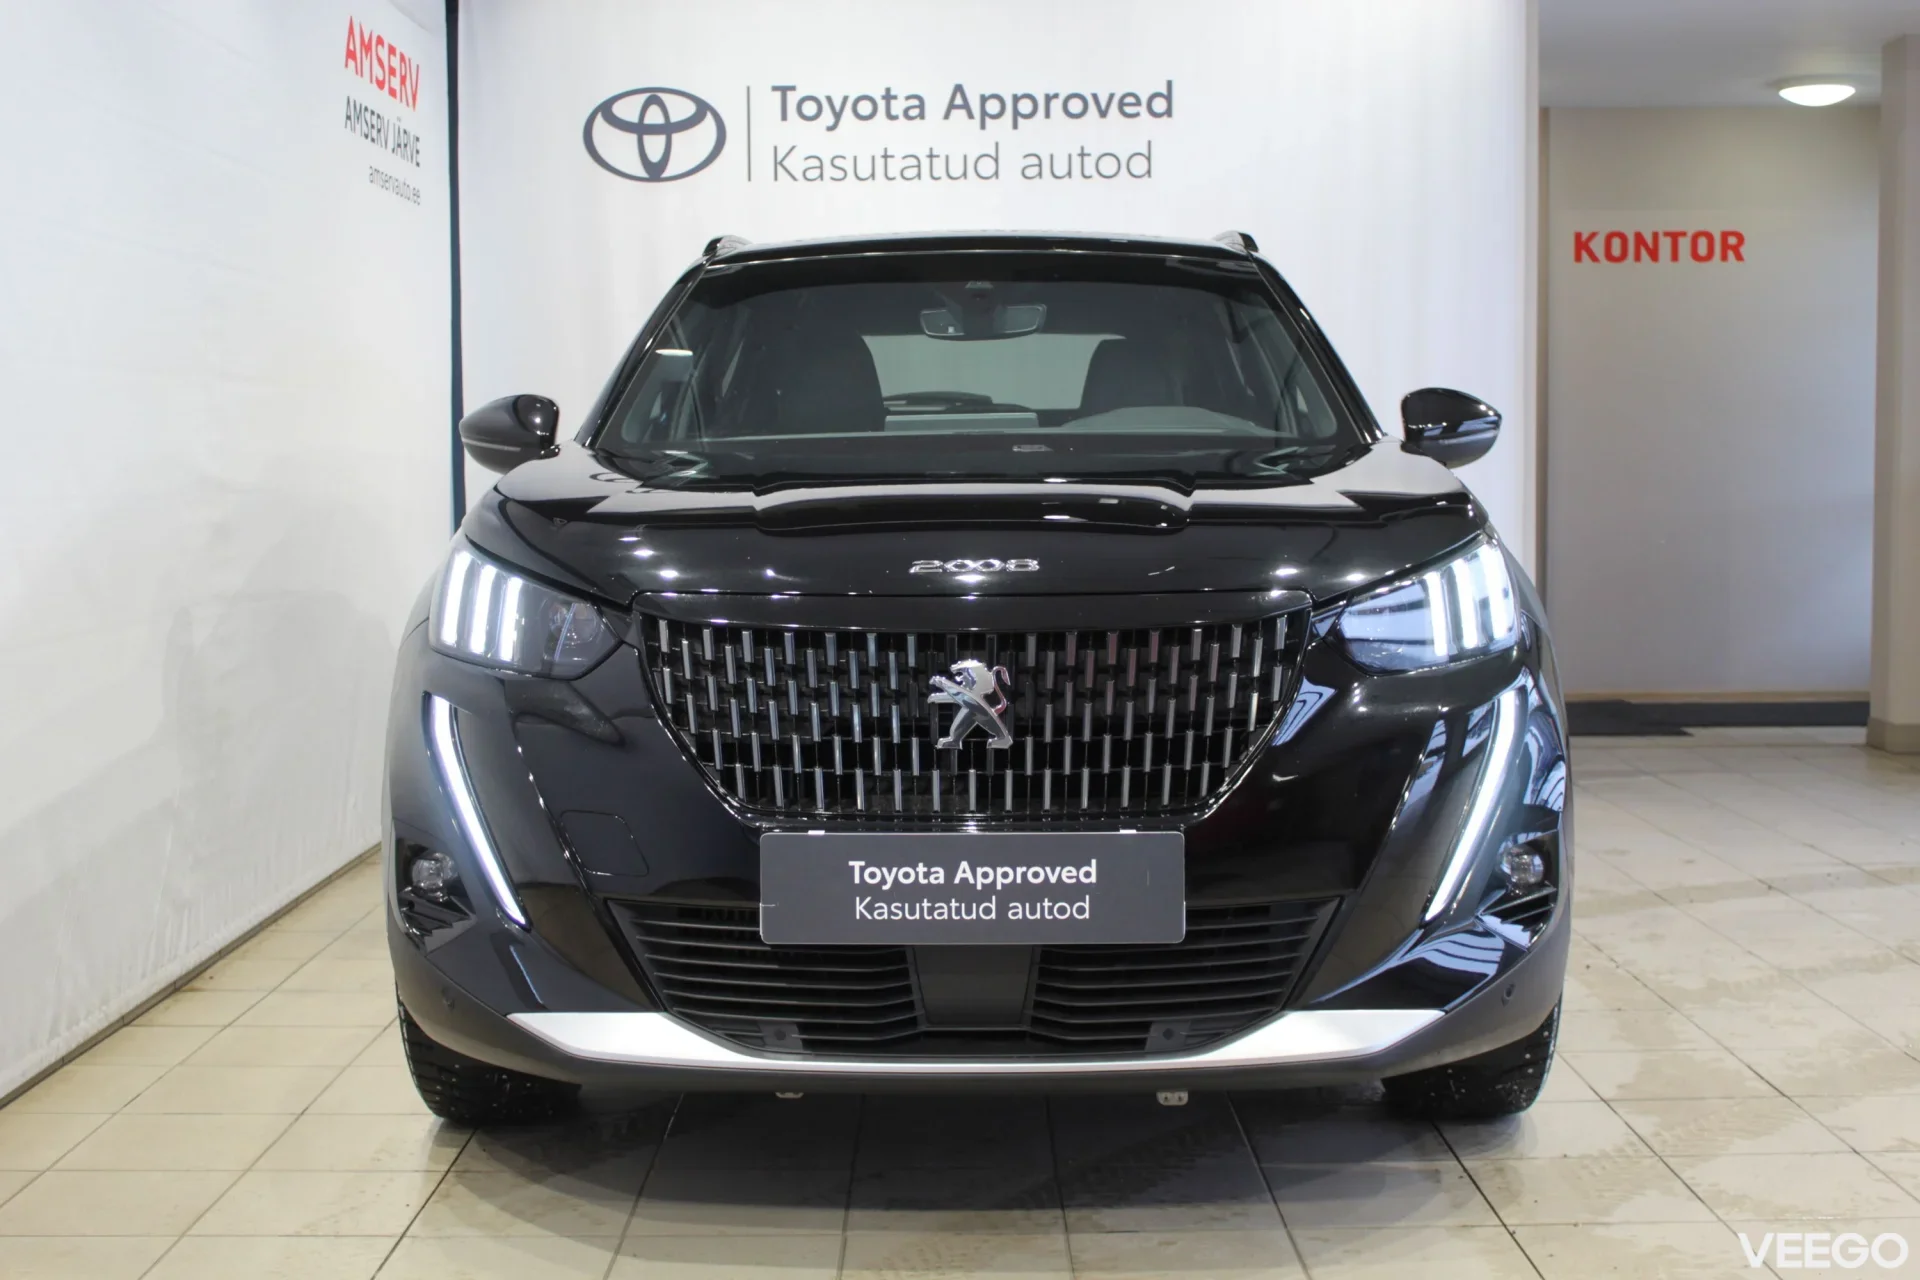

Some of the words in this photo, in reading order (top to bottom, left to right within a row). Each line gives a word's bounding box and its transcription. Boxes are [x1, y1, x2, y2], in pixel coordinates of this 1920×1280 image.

[345, 15, 420, 112] AMSERV
[771, 85, 926, 131] Toyota
[943, 80, 1174, 130] Approved
[344, 96, 389, 151] AMSERV
[391, 116, 420, 168] JÄRVE
[772, 142, 1000, 182] Kasutatud
[1020, 140, 1153, 180] autod
[369, 165, 420, 206] amservauto.ee
[1573, 230, 1746, 264] KONTOR
[909, 559, 1040, 573] 2008
[848, 860, 945, 890] Toyota
[953, 859, 1097, 889] Approved
[854, 896, 996, 921] Kasutatud
[1007, 895, 1090, 919] autod
